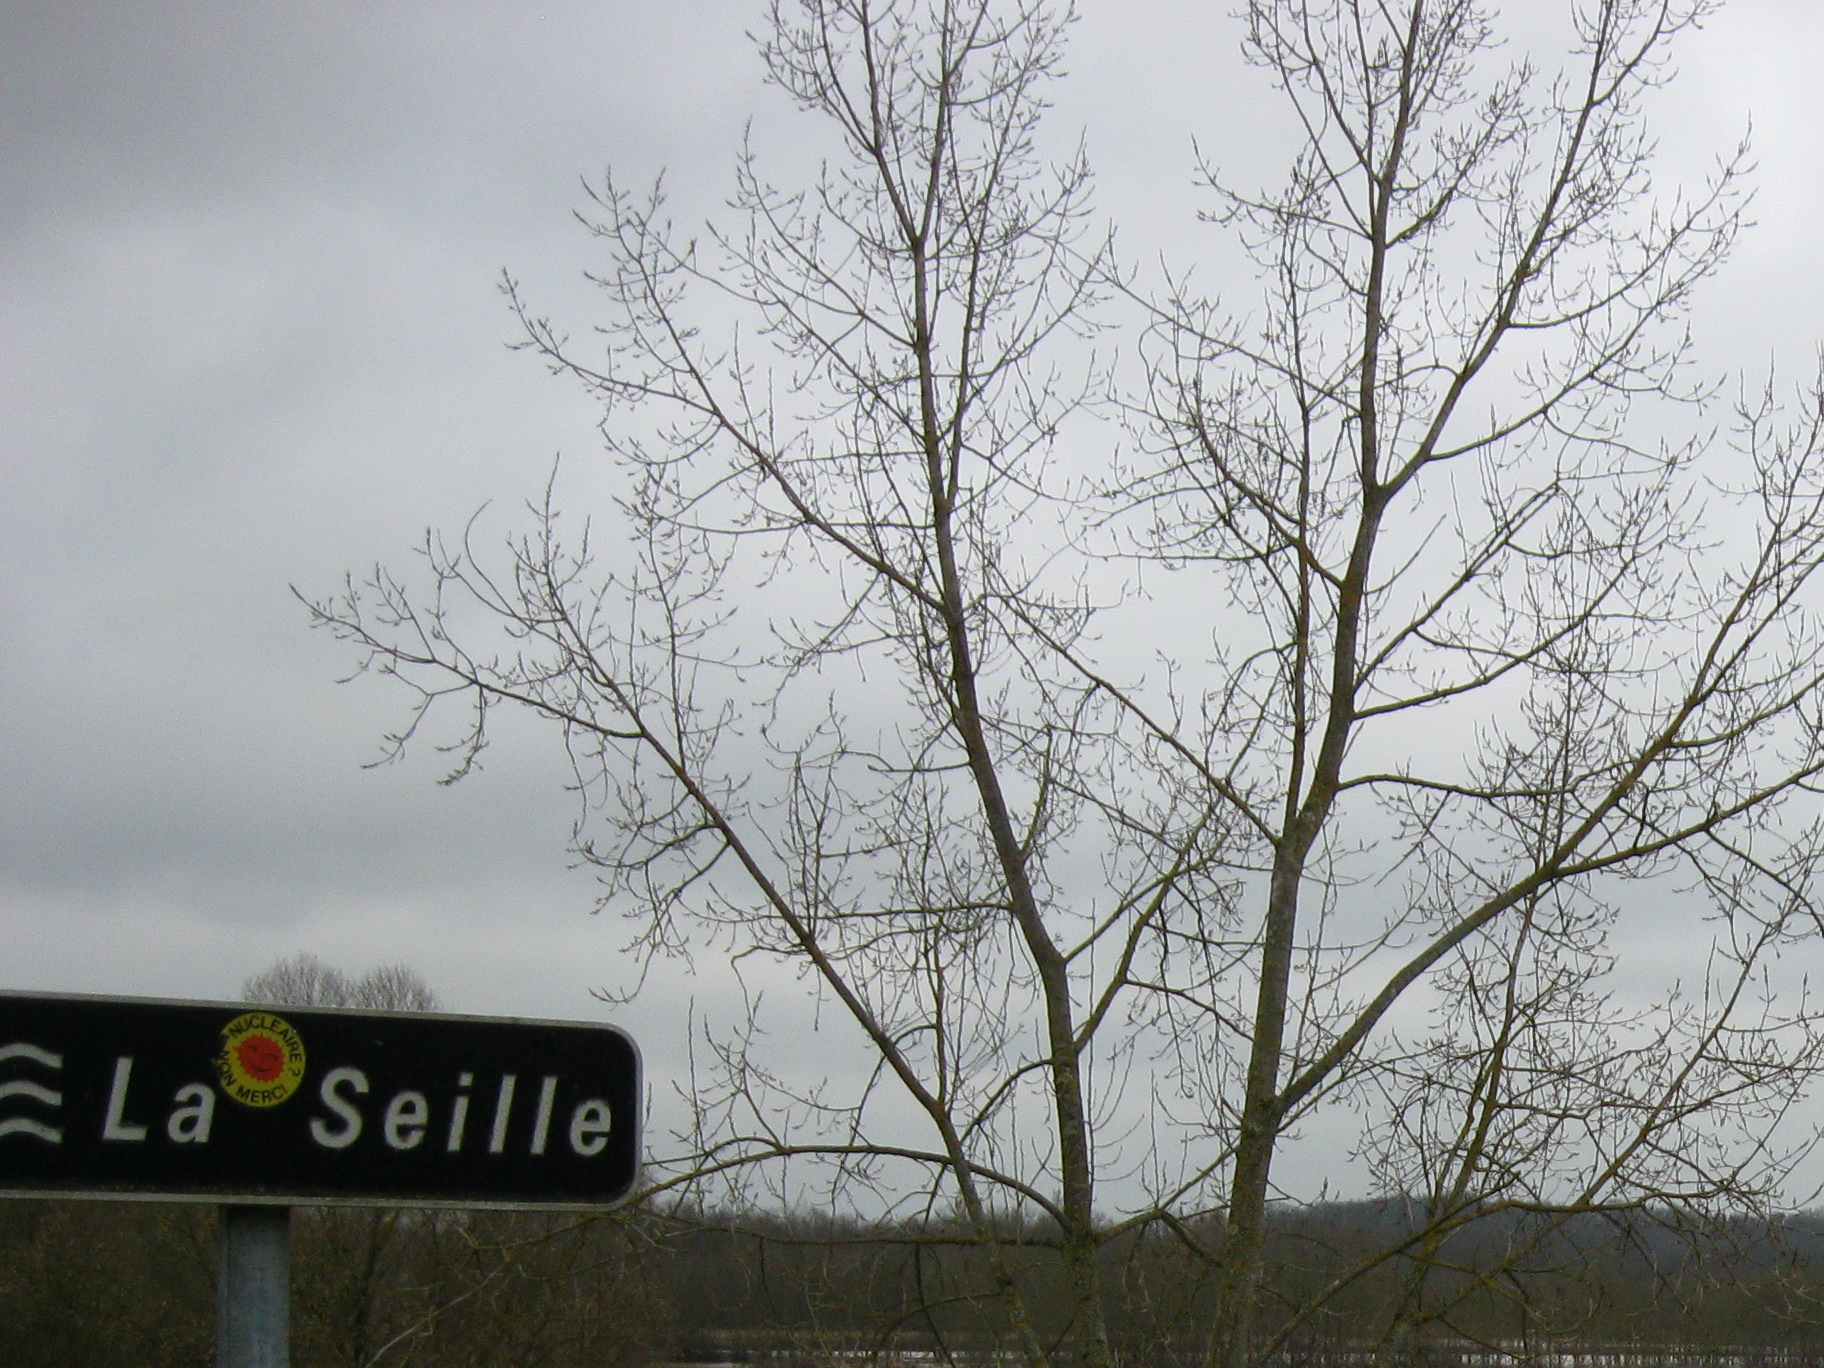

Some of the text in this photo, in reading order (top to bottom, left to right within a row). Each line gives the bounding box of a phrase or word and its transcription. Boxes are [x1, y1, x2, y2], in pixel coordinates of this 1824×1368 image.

[228, 1014, 302, 1063] NUCLEAIRE
[217, 1050, 288, 1104] NON MERCI
[102, 1056, 613, 1157] La Seille
